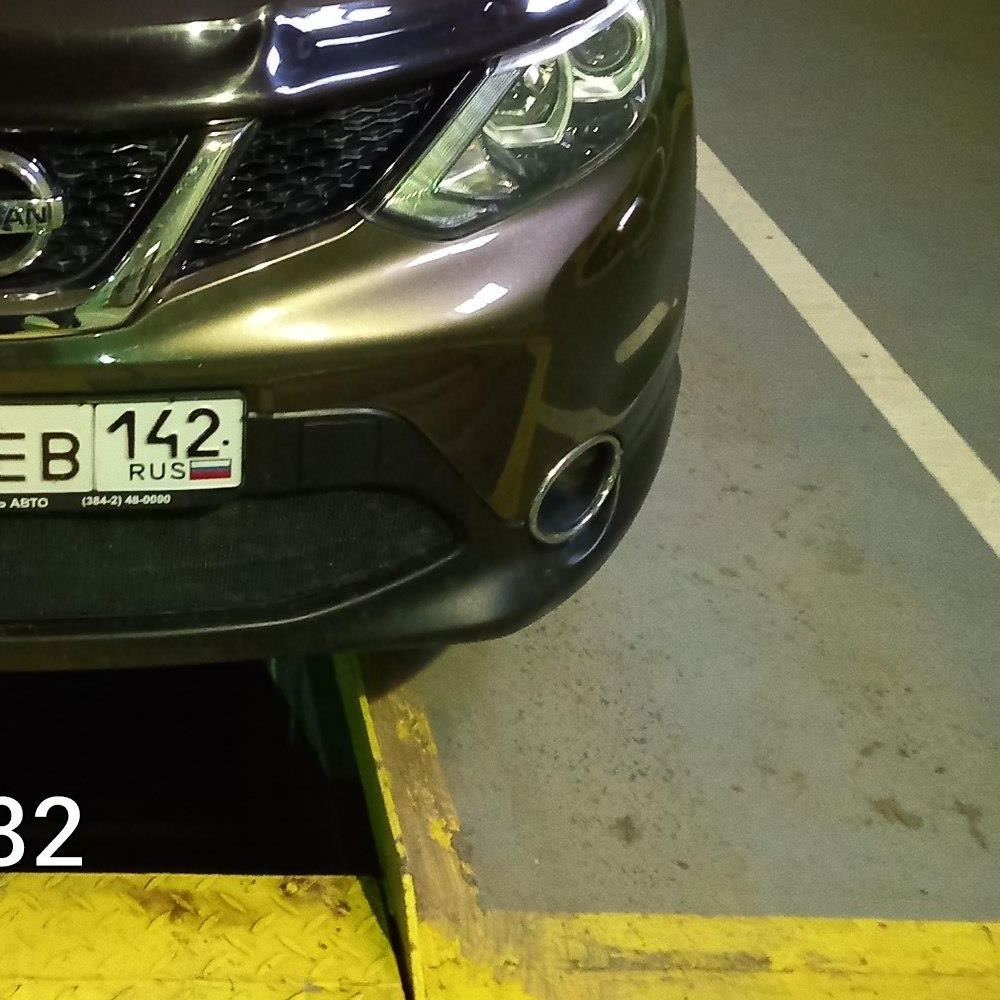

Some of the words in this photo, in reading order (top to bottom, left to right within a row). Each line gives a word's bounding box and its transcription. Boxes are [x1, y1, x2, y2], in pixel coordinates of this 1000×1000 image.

[106, 407, 220, 459] 142
[129, 462, 186, 480] RUS
[9, 498, 49, 508] АВТО
